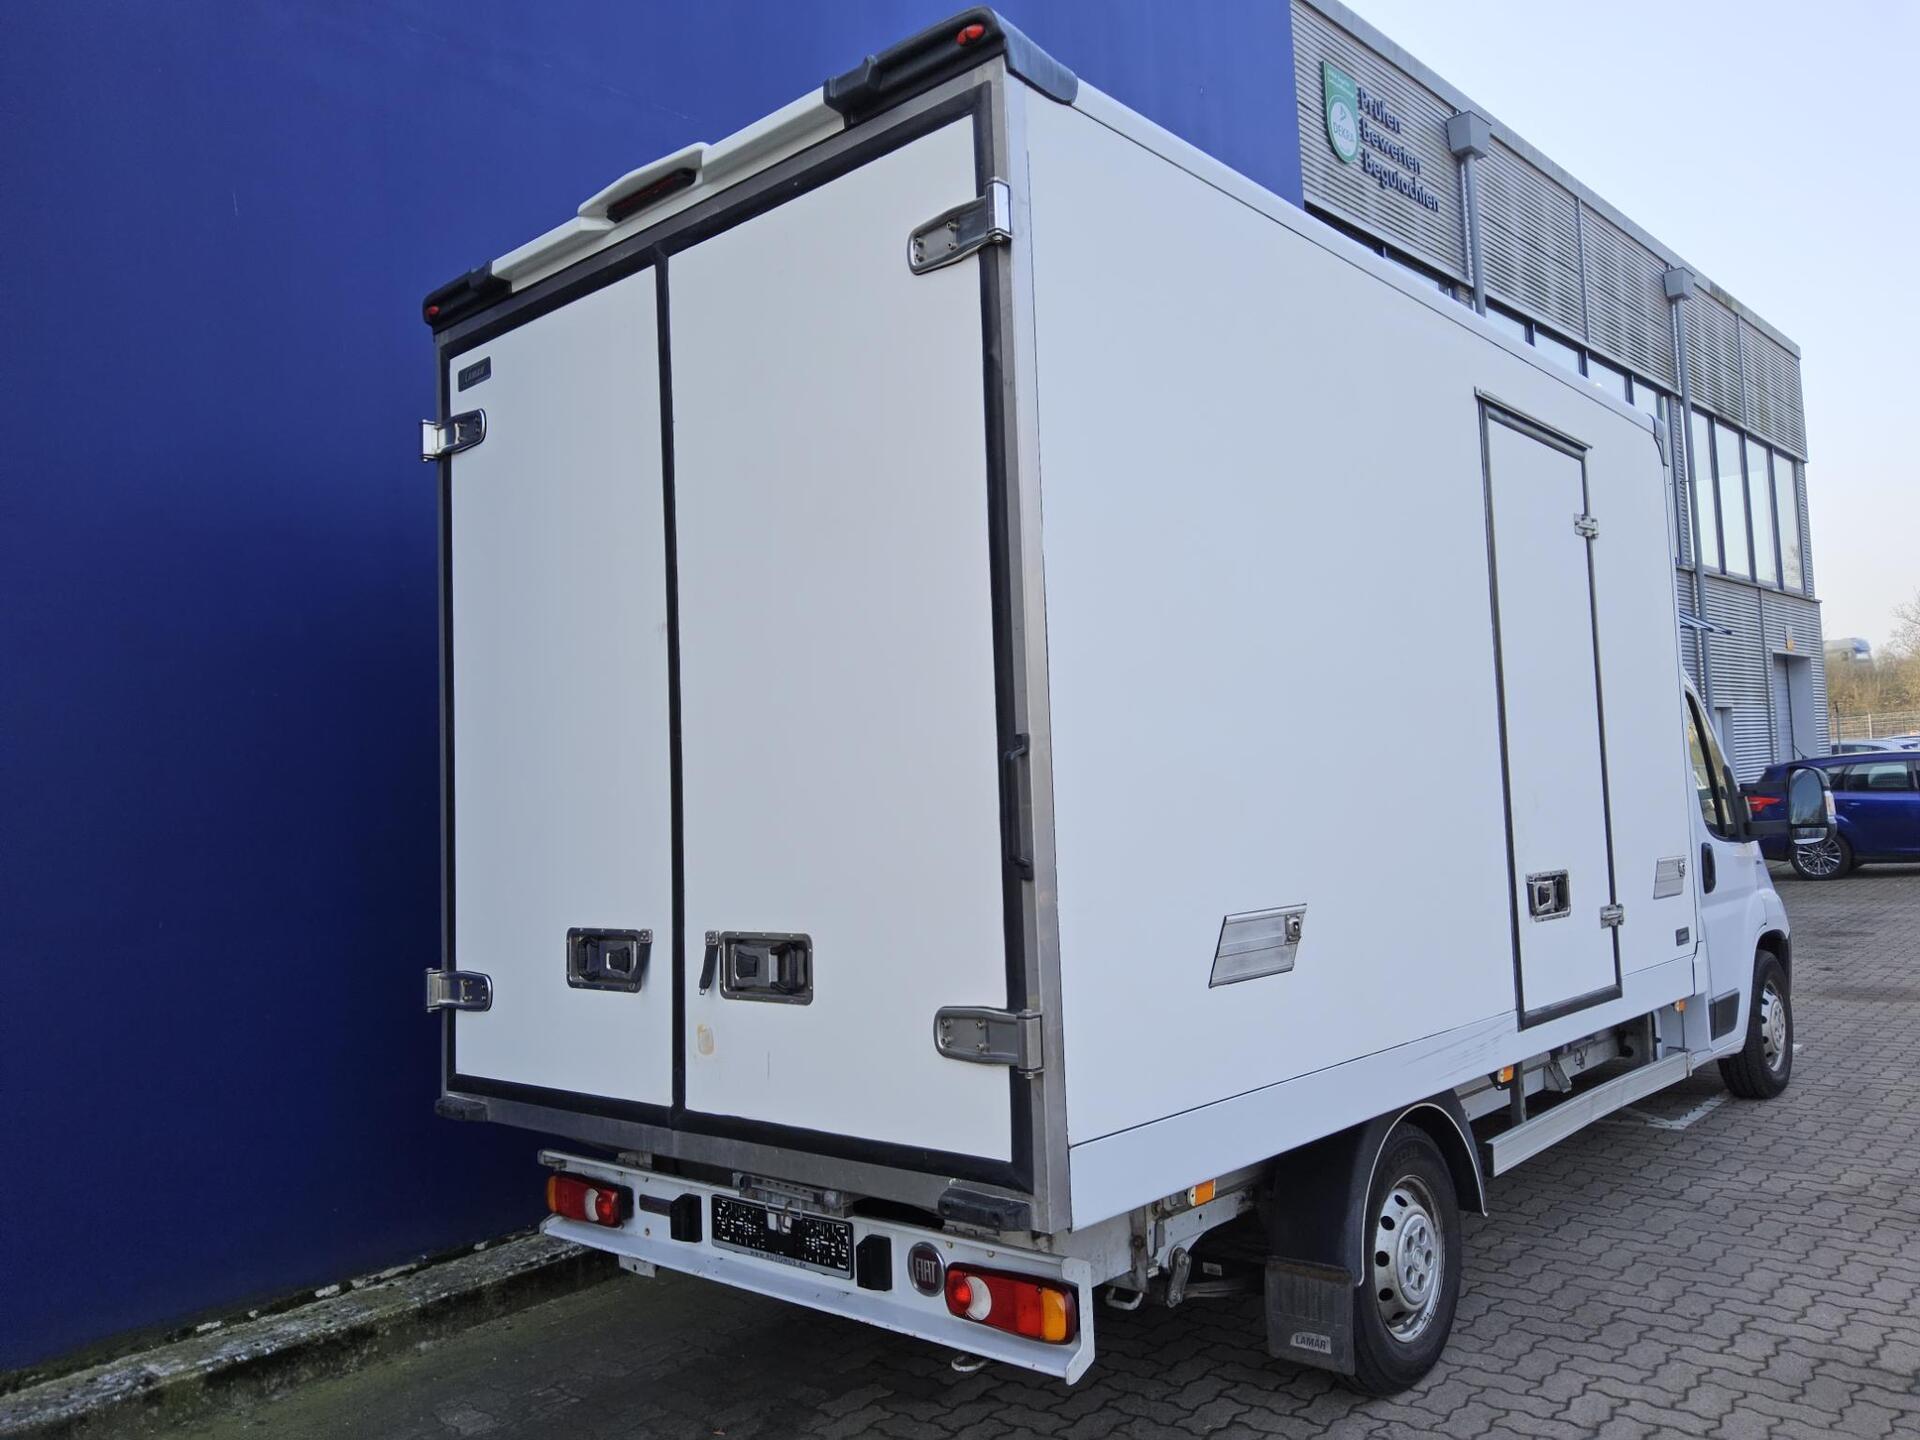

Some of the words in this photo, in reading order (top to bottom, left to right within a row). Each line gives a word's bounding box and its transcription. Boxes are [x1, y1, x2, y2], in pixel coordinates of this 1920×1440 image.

[1358, 87, 1402, 134] Prüfen
[1359, 116, 1421, 175] Bewerten
[1362, 148, 1440, 212] Begutachten
[915, 1257, 937, 1285] FIAT
[1296, 1335, 1326, 1350] LAMAR
